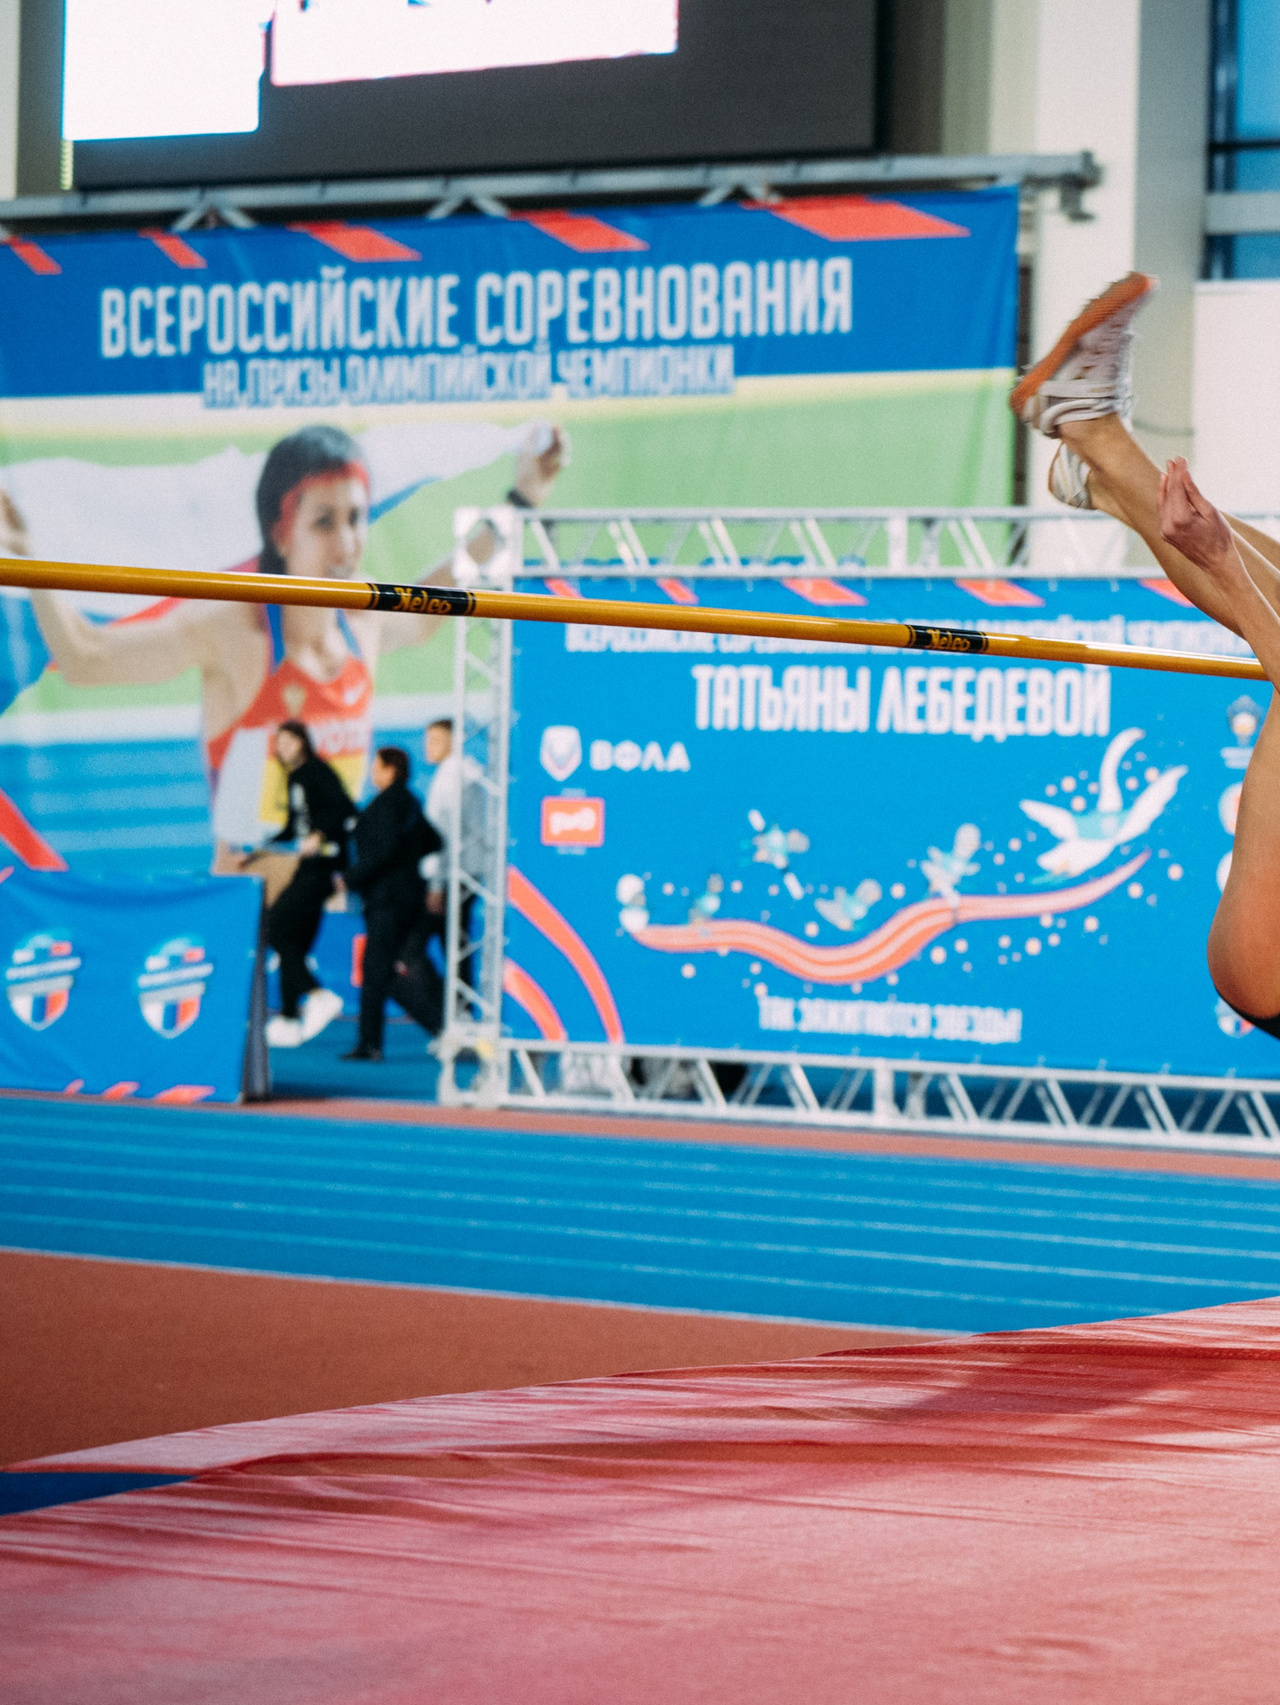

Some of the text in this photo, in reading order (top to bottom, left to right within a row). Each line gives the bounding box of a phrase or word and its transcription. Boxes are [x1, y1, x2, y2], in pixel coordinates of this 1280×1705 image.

[100, 256, 853, 358] ВСЕРОССИЙСКИЕ СОРЕВНОВАНИЯ
[202, 344, 735, 408] НА ПРИЗЫ ОЛИМПИЙСКОЙ ЧЕМПИОНКИ
[392, 586, 452, 614] Nelco
[690, 661, 1112, 743] ТАТЬЯНЫ ЛЕБЕДЕВОЙ
